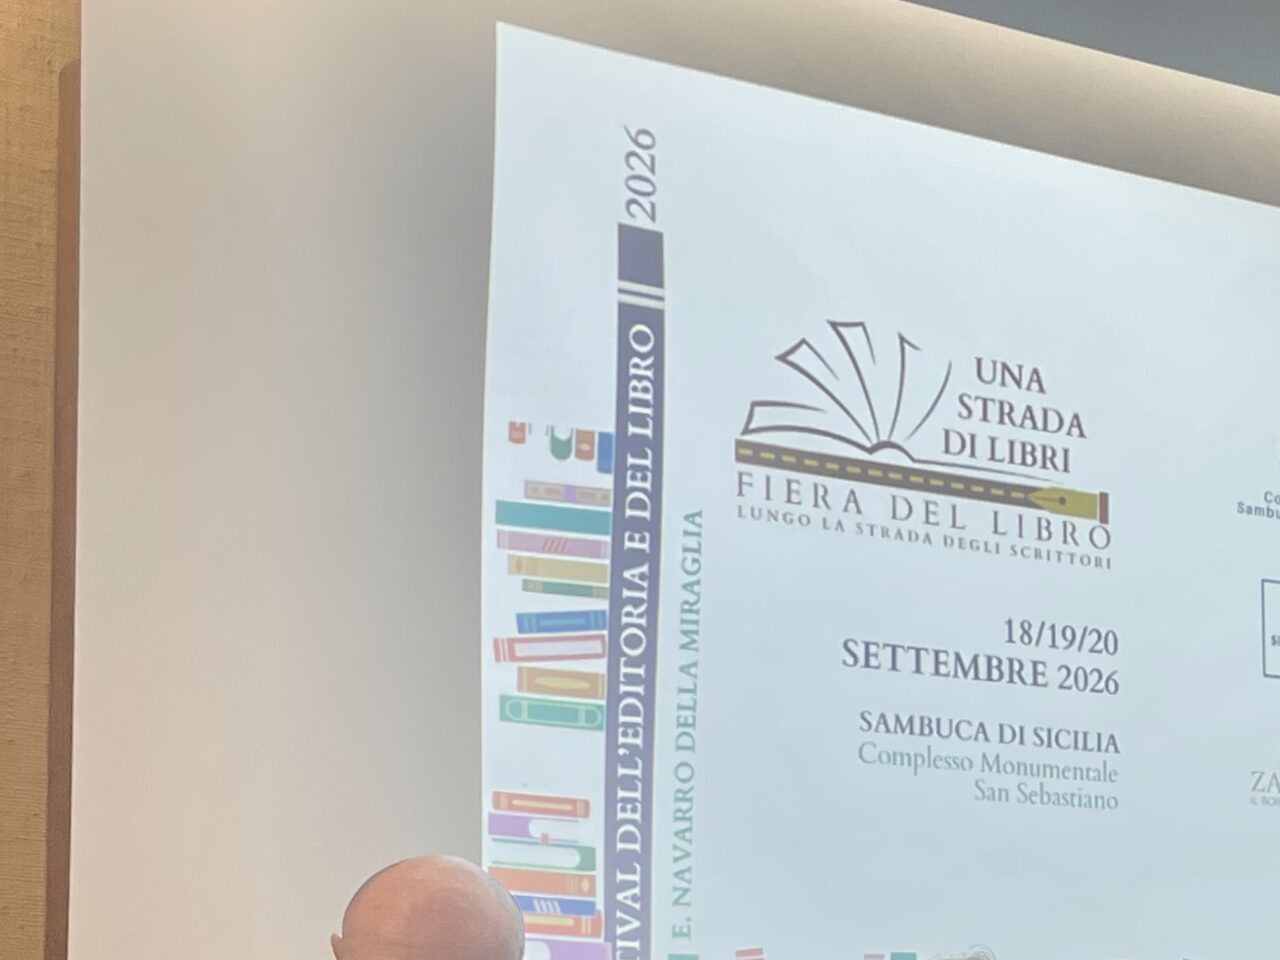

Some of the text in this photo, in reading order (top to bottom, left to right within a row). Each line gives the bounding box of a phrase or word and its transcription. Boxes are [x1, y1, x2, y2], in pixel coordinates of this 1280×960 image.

[625, 125, 656, 223] 2026
[628, 323, 654, 438] LIBRO
[975, 357, 1046, 394] UNA
[958, 393, 1087, 439] STRADA
[943, 428, 1071, 473] DI LIBRI
[625, 448, 652, 521] DEL
[737, 471, 1111, 551] FIERA DEL LIBRO
[624, 531, 650, 553] E
[737, 505, 1111, 570] LUNGO LA STRADA DEGLI SCRITTORI
[1004, 617, 1119, 656] 18/19/20
[842, 638, 1120, 695] SETTEMBRE 2026
[616, 563, 650, 853] DELL'EDITORIA
[672, 510, 703, 942] E. NAVARRO DELLA MIRAGLIA
[859, 710, 1121, 754] SAMBUCA DI SICILIA
[858, 741, 1119, 783] Complesso Monumentale
[974, 779, 1119, 810] San Sebastiano
